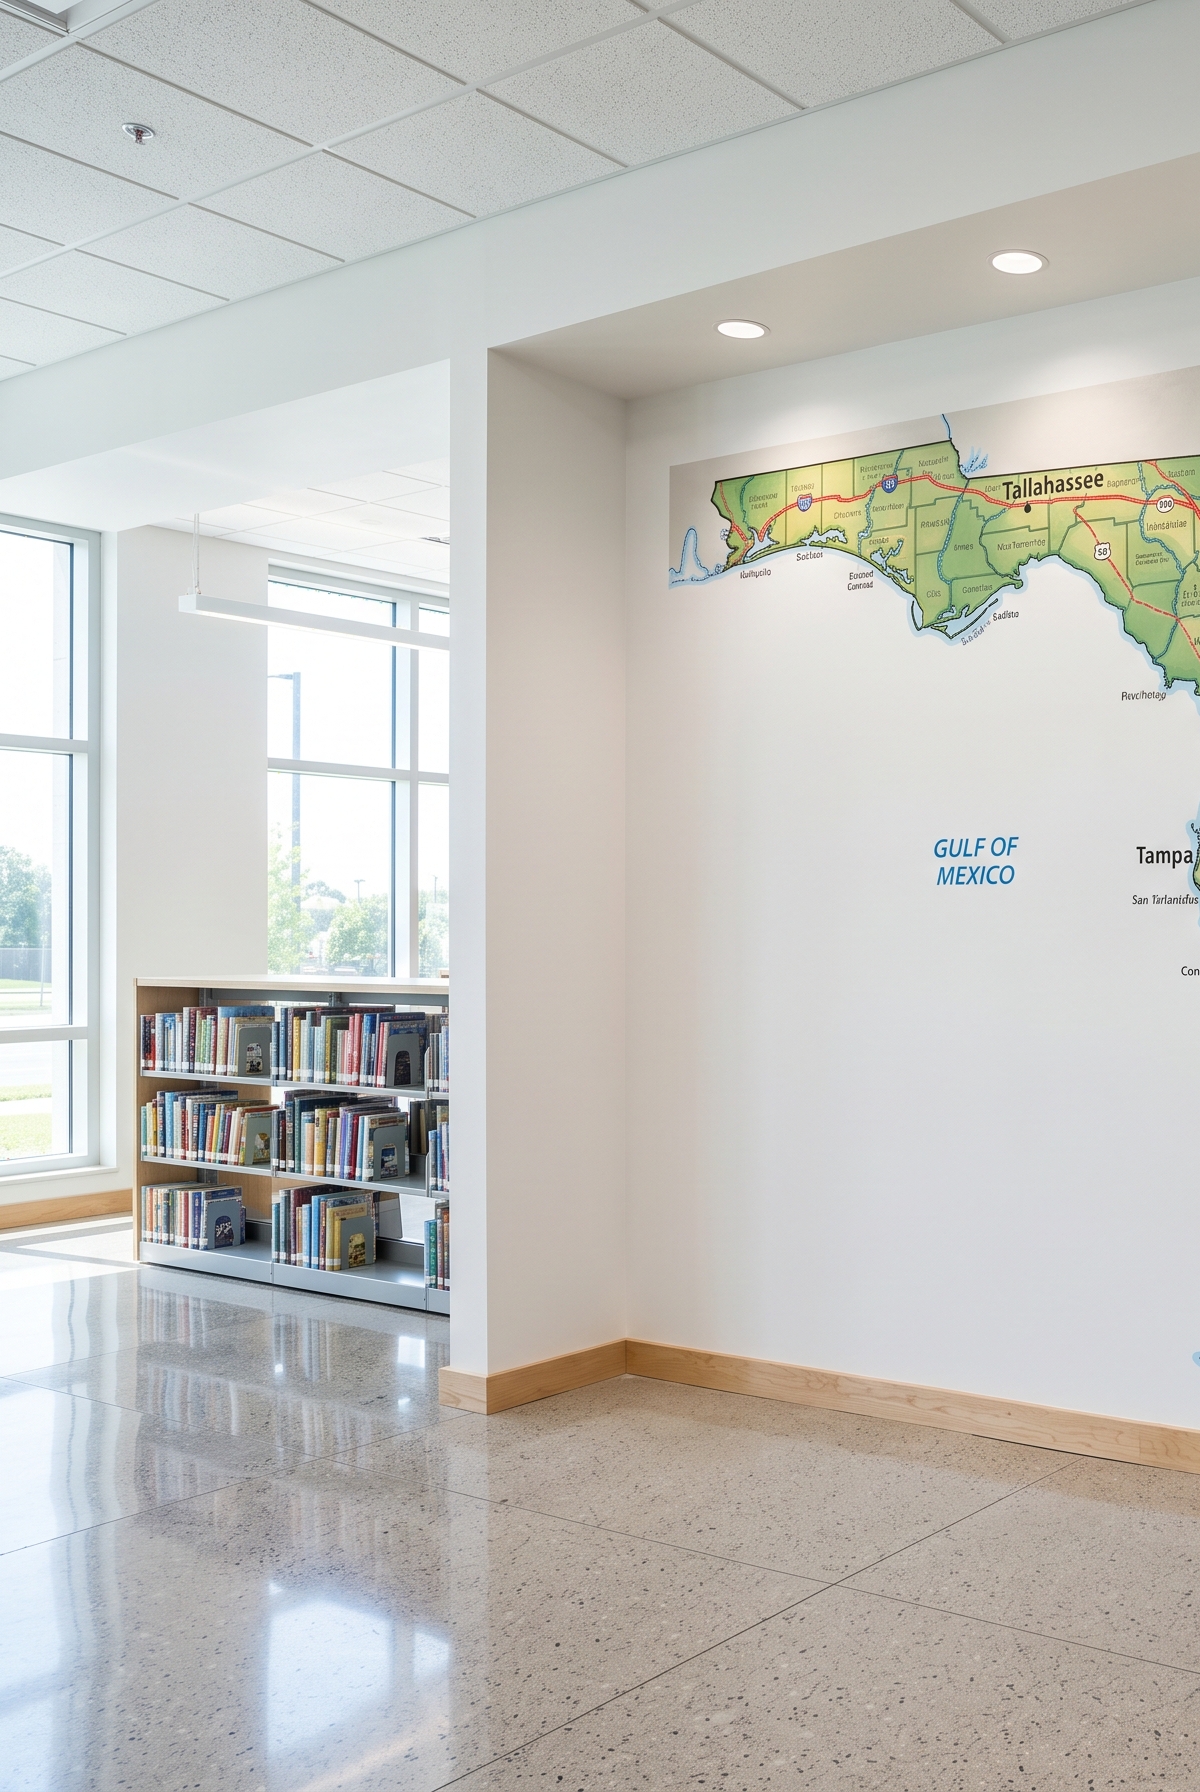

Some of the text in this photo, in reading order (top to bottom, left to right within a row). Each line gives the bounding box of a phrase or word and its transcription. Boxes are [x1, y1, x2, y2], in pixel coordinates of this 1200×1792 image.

[1002, 472, 1104, 500] Tallahassee
[934, 836, 1019, 858] GULF OF
[1136, 846, 1193, 868] Tampa
[936, 865, 1015, 886] MEXICO
[1132, 895, 1149, 905] San
